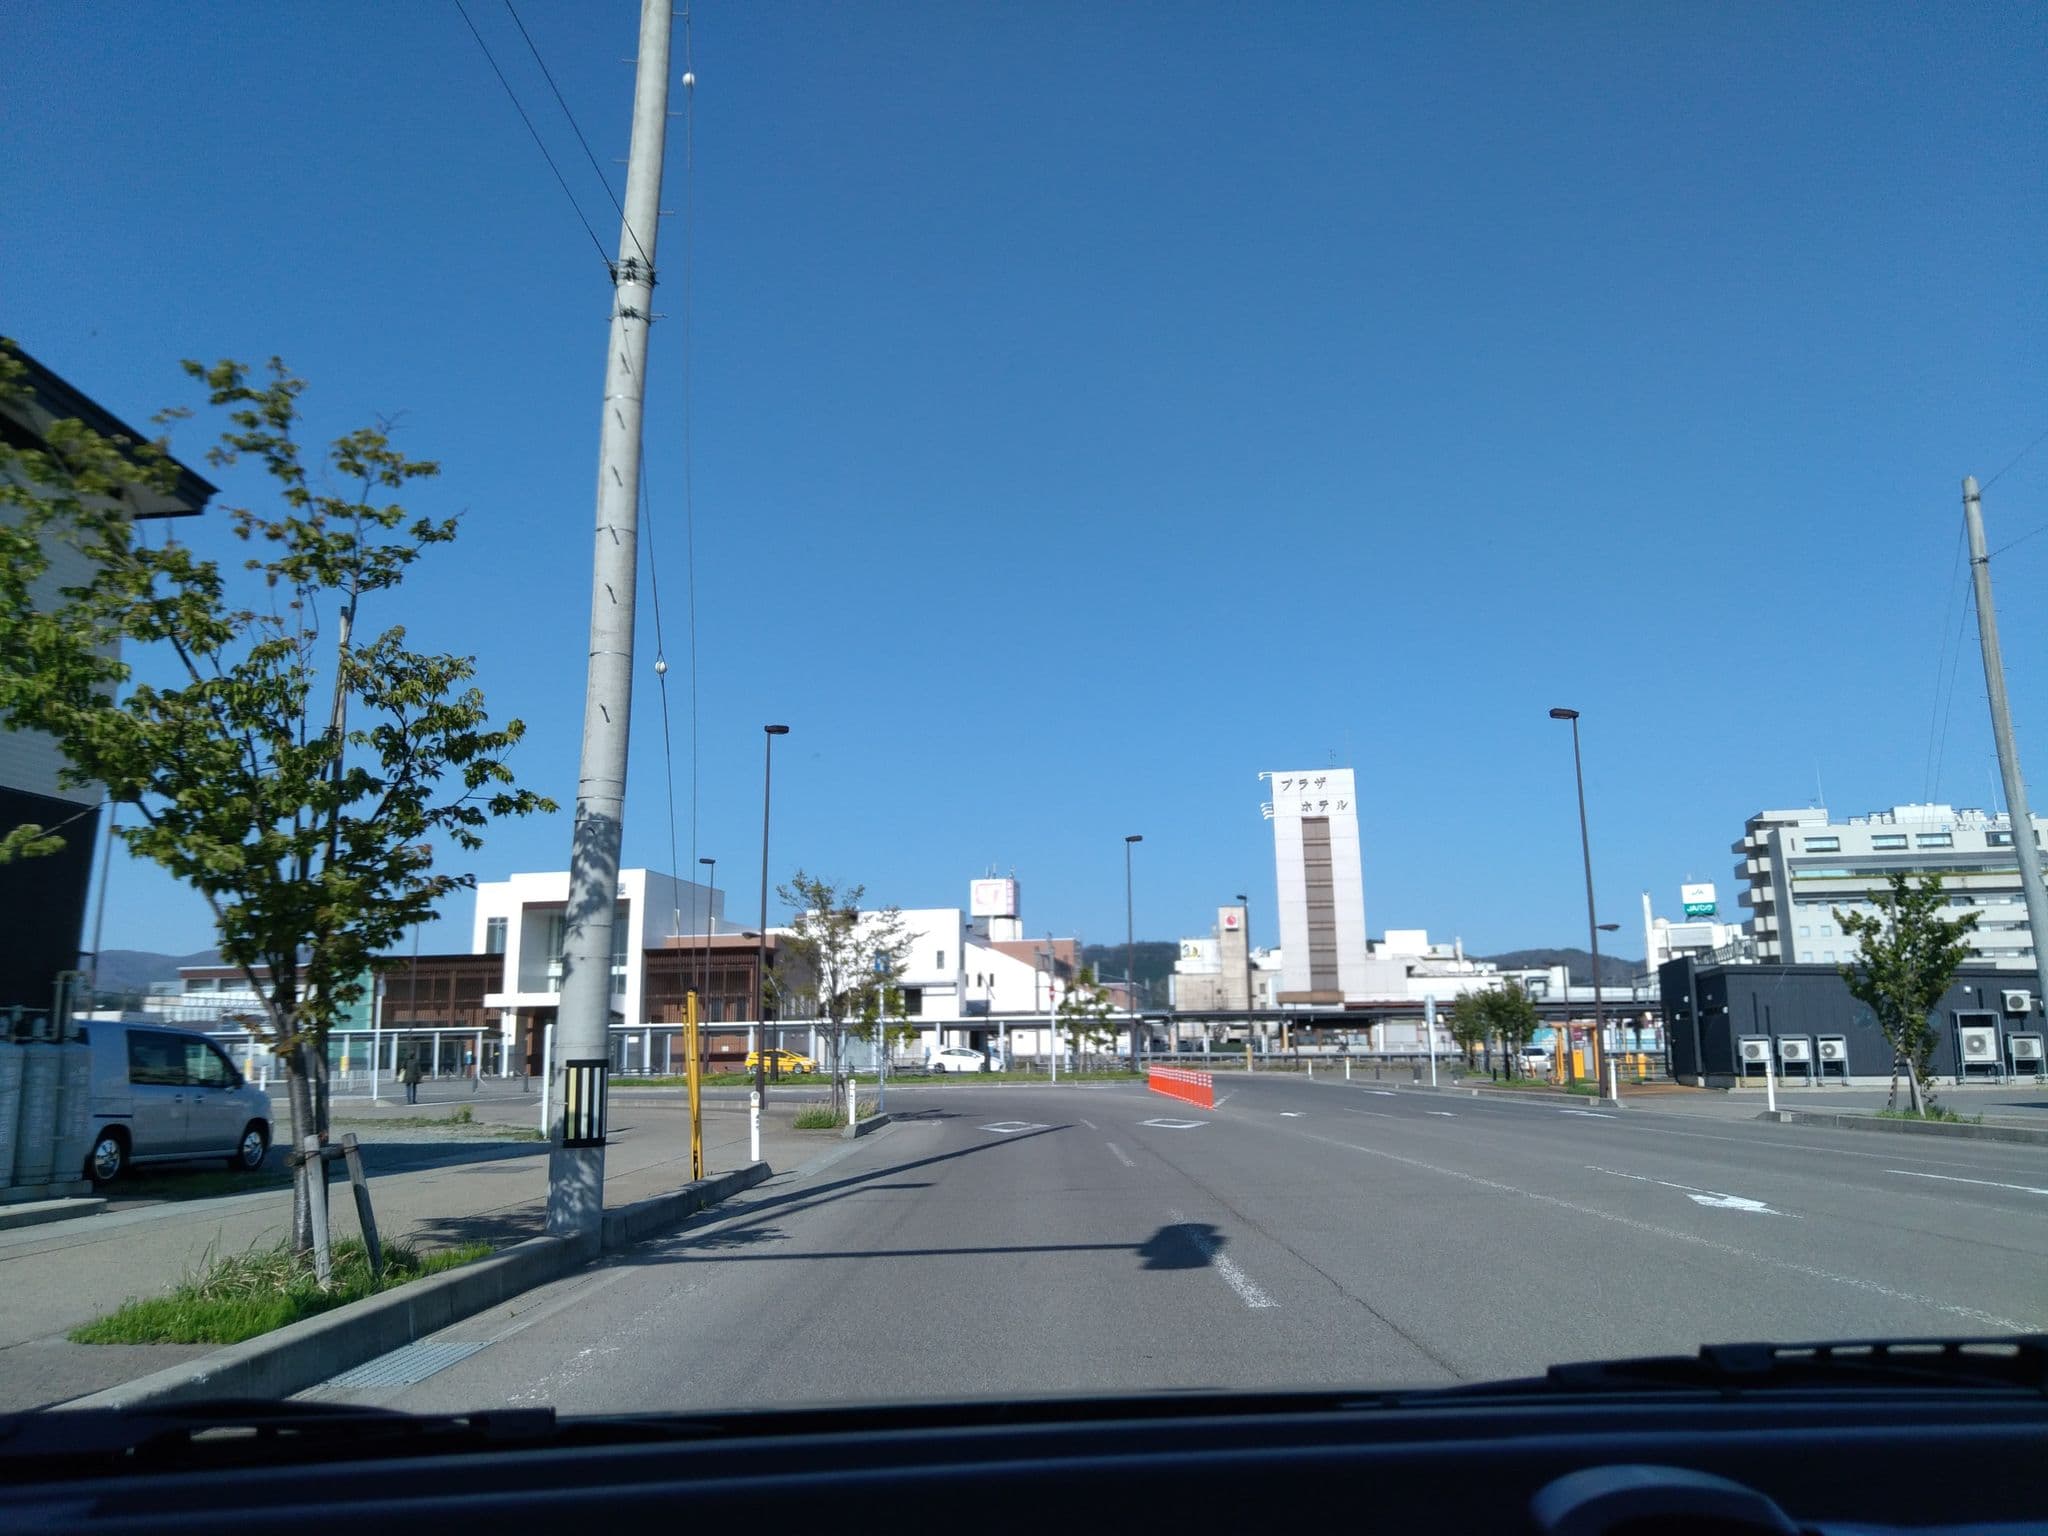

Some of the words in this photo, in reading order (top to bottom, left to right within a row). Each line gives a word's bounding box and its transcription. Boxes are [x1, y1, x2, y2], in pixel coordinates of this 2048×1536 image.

[1281, 777, 1326, 791] プラザ
[1301, 800, 1348, 812] ホテル
[1941, 823, 1976, 832] PLAZA
